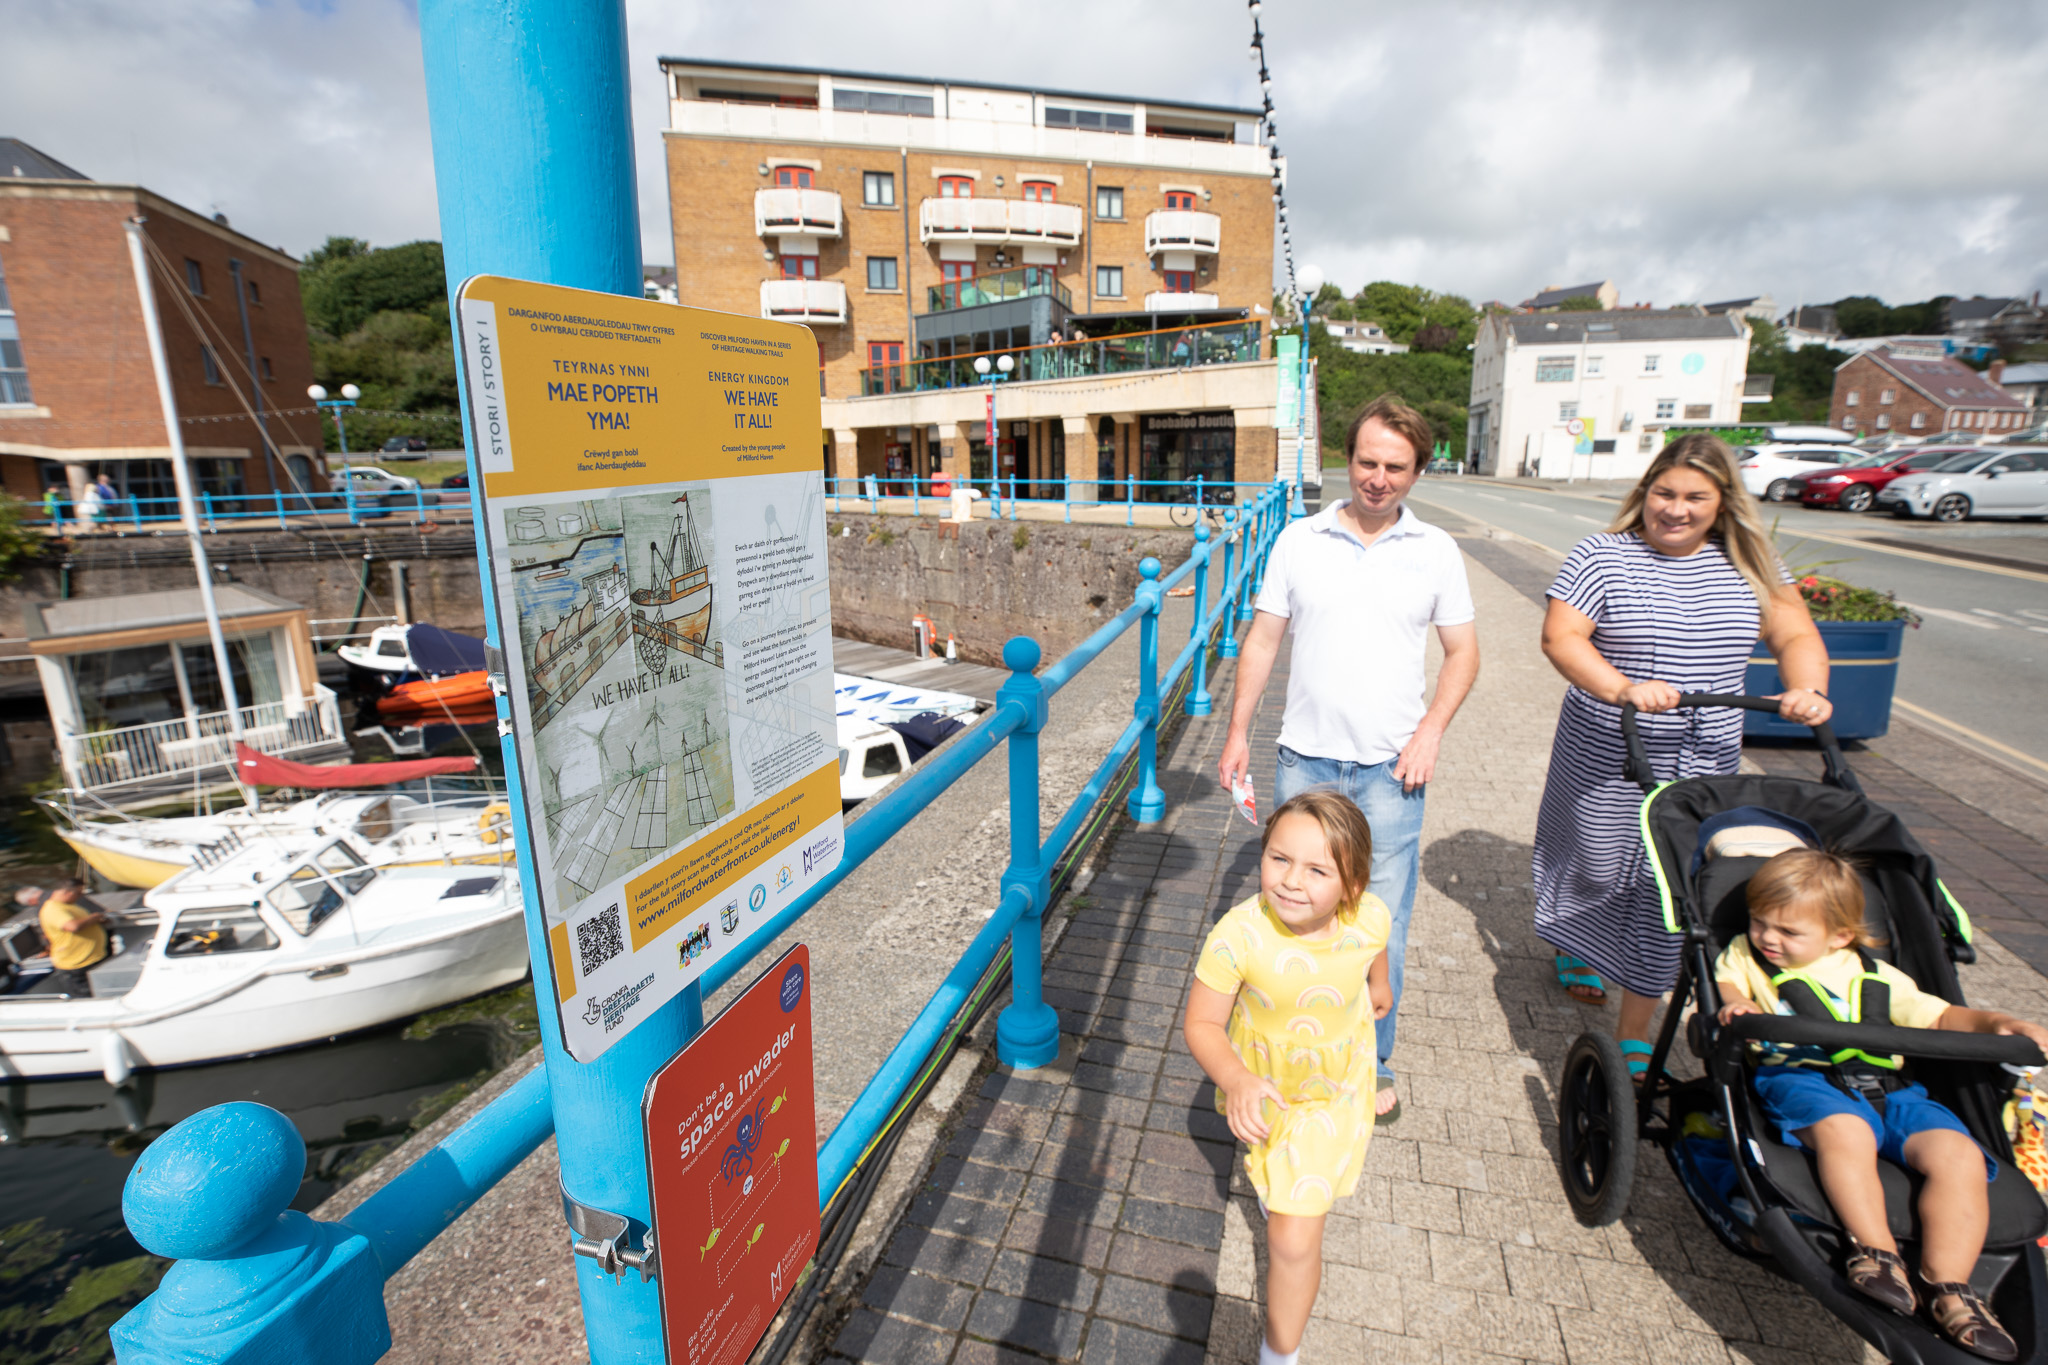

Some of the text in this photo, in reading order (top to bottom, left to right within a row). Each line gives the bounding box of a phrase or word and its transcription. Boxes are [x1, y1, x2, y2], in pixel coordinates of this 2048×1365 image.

[508, 307, 675, 336] DARGANFOD ABERDAUGLEDDAU TRWY GYFRES
[531, 323, 661, 345] O LWYBRAU CERDDED TREFTADAETH
[700, 332, 727, 342] DISCOVER
[727, 335, 750, 345] MILFORD
[750, 339, 767, 347] HAVEN
[777, 342, 792, 350] SERIES
[711, 343, 783, 358] OF HERITAGE WALKING TRAILS
[478, 333, 495, 391] STORY
[552, 360, 650, 378] TEYRNAS YNNI
[708, 371, 789, 386] ENERGY KINGDOM
[547, 382, 659, 404] MAE POPETH
[724, 390, 778, 407] WE HAVE
[487, 406, 504, 456] STORI
[587, 412, 630, 430] YMA!
[734, 413, 772, 429] IT ALL!
[612, 451, 623, 459] gan
[625, 448, 639, 457] bobl
[722, 443, 786, 453] Created by the young people
[737, 454, 742, 462] of
[743, 454, 759, 462] Milford
[595, 460, 647, 471] Aberdaugleddau
[742, 640, 749, 648] Go
[760, 632, 776, 643] journey
[777, 628, 787, 636] from
[803, 618, 817, 628] present
[569, 641, 583, 655] LNG
[743, 651, 751, 659] and
[760, 645, 771, 653] what
[779, 638, 791, 647] future
[792, 634, 802, 642] holds
[744, 660, 760, 671] Milford
[775, 650, 787, 659] Learn
[788, 645, 799, 654] about
[745, 673, 760, 682] energy
[760, 665, 777, 676] industry
[795, 655, 804, 663] right
[746, 682, 765, 694] doorstep
[774, 673, 783, 681] how
[801, 660, 817, 671] changing
[592, 663, 690, 710] WE HAVE IT ALL!
[755, 691, 767, 700] world
[639, 880, 664, 900] ddarllen
[690, 855, 704, 868] llawn
[705, 839, 729, 858] sganiwch
[734, 829, 743, 840] cod
[744, 823, 753, 834] QR
[753, 819, 762, 828] neu
[763, 807, 780, 822] cliciwch
[790, 792, 804, 805] ddolen
[636, 903, 647, 914] For
[649, 895, 659, 906] the
[660, 887, 670, 898] full
[671, 878, 686, 893] story
[687, 870, 700, 881] scan
[700, 863, 710, 873] the
[710, 855, 720, 866] QR
[721, 847, 733, 860] code
[734, 843, 740, 851] or
[741, 836, 751, 846] visit
[751, 831, 760, 840] the
[601, 984, 629, 1009] CRONFA
[602, 972, 655, 1016] DREFTADAETH
[604, 994, 641, 1026] HERITAGE
[605, 1015, 624, 1034] FUND
[681, 1023, 796, 1160] space invader
[678, 1082, 724, 1136] Don't be a
[682, 1155, 698, 1175] Please
[688, 1331, 698, 1348] Be
[699, 1308, 714, 1332] safe
[689, 1343, 699, 1360] Be
[700, 1292, 734, 1343] courteous
[701, 1329, 717, 1355] kind
